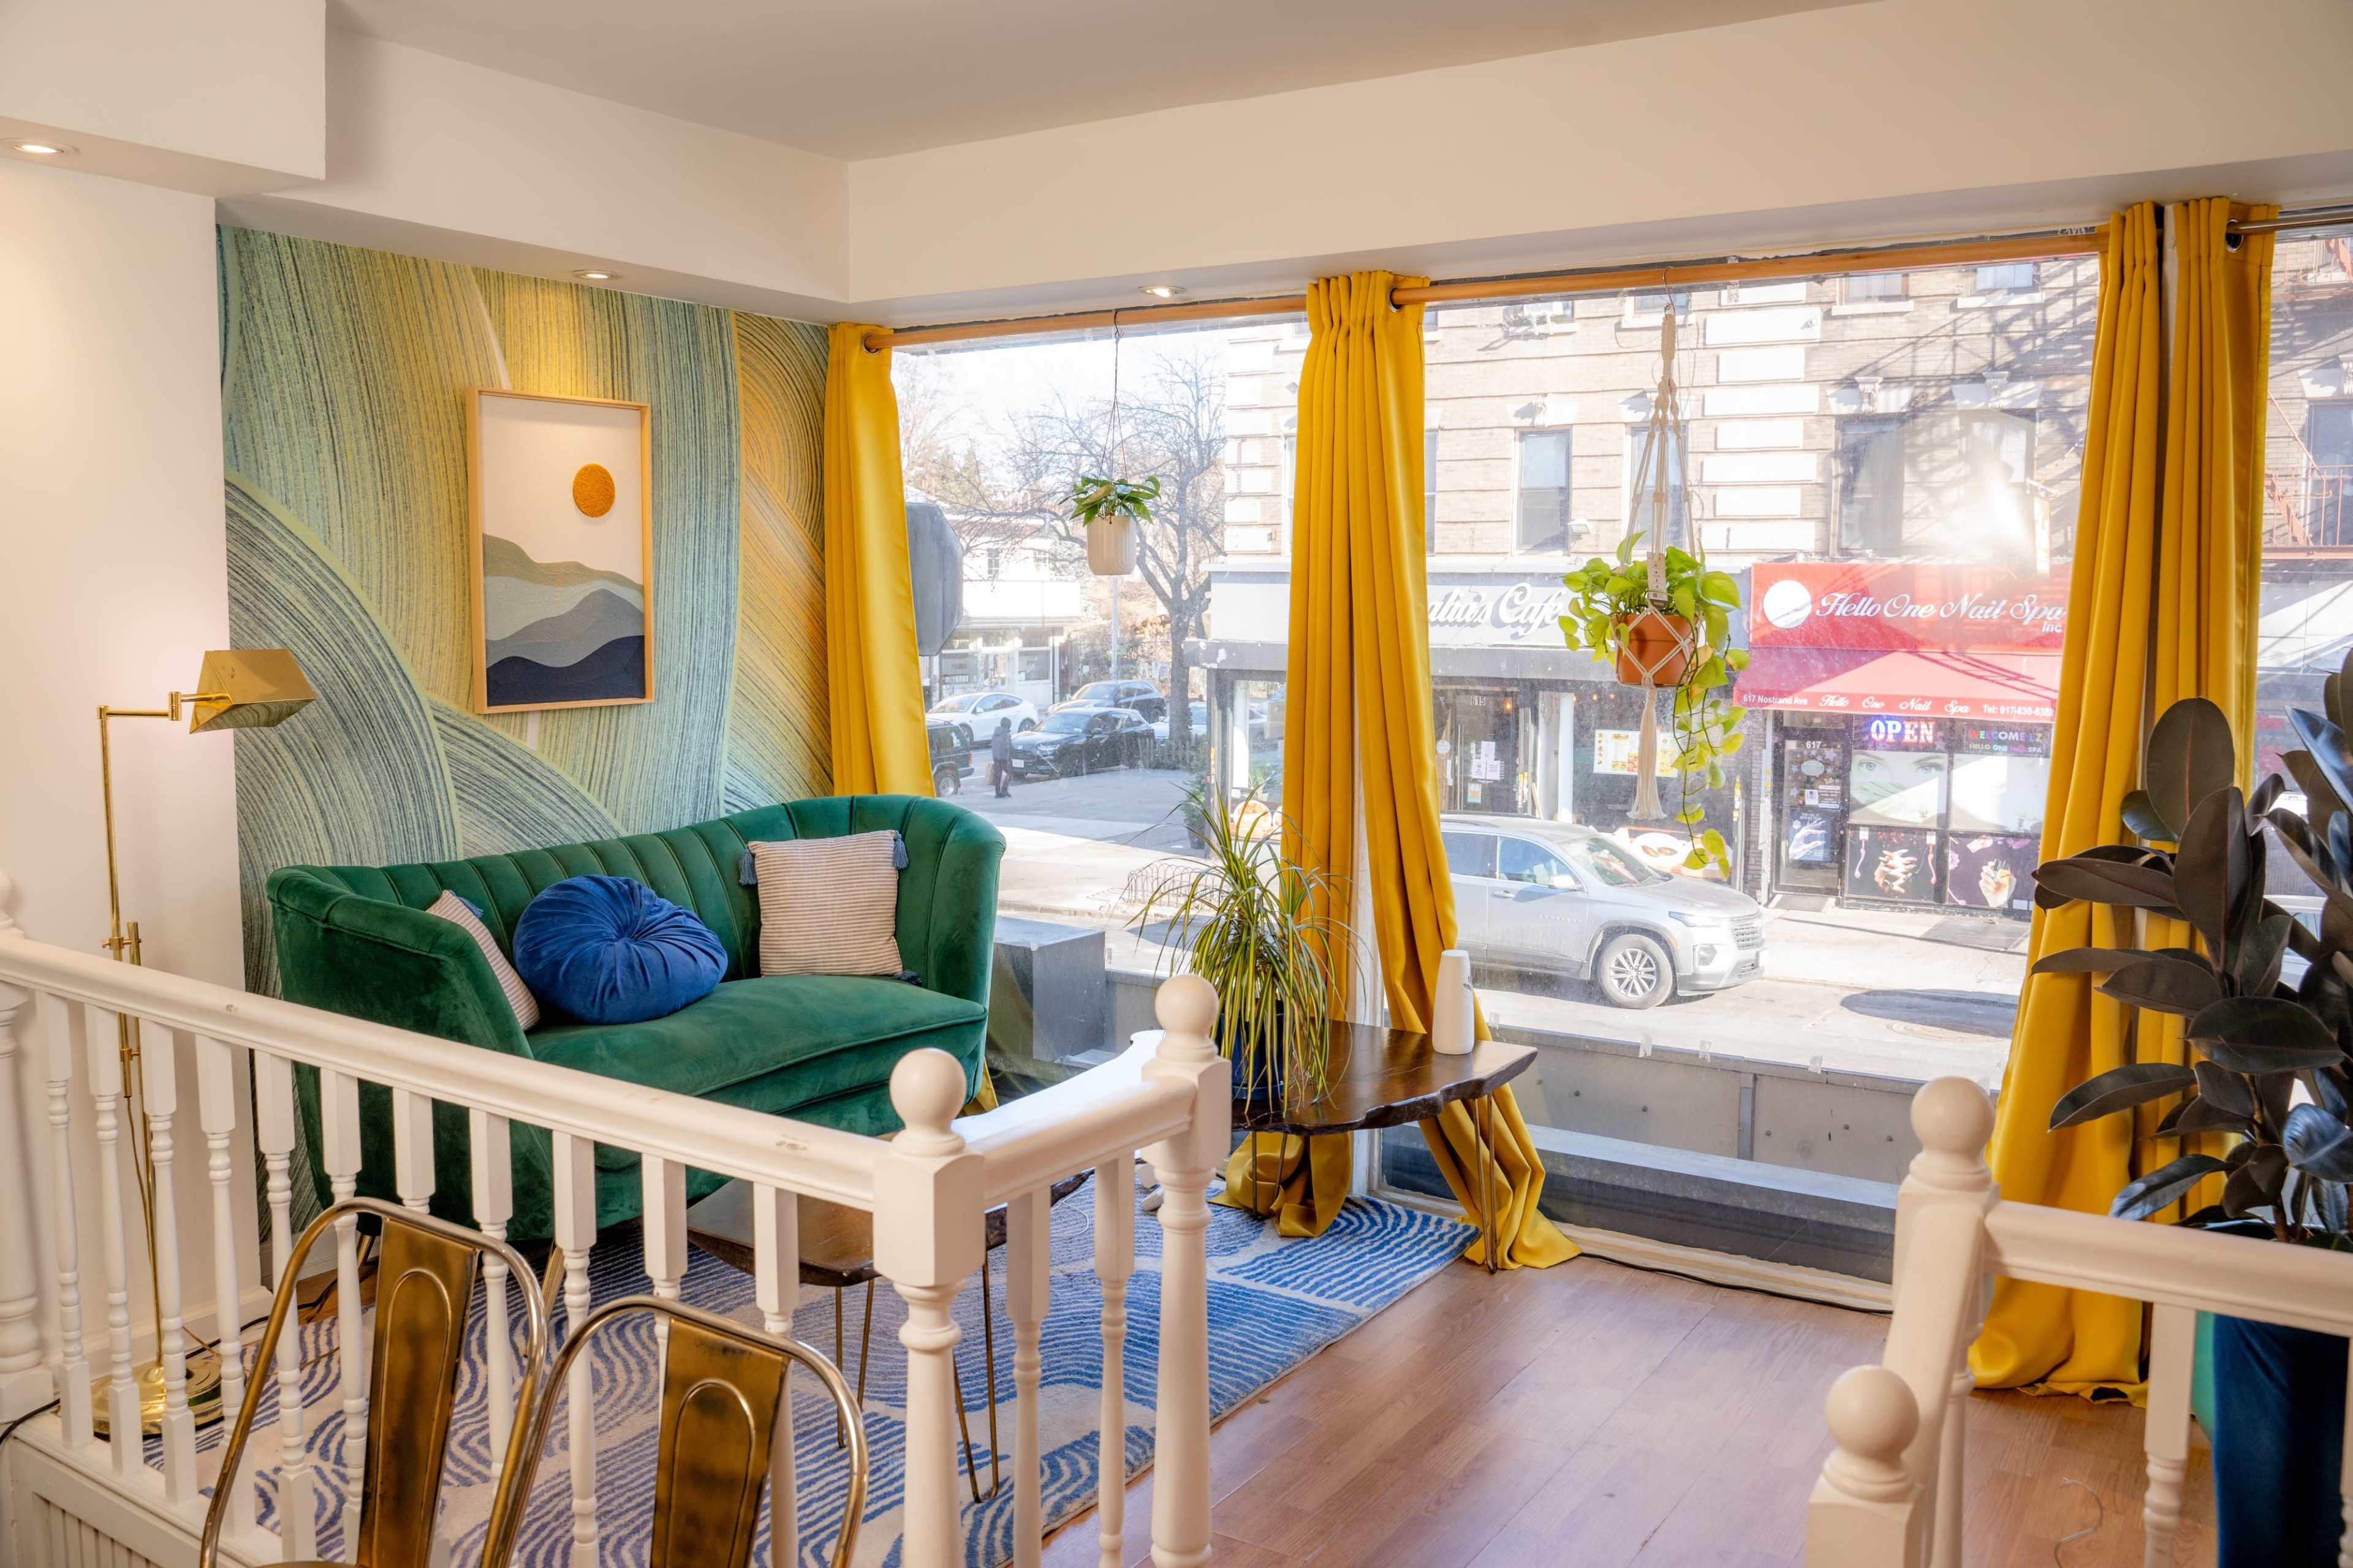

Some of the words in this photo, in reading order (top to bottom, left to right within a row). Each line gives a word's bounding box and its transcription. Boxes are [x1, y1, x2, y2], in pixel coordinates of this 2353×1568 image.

[1816, 592, 1881, 617] Hello
[1884, 593, 1936, 618] One
[1939, 593, 2007, 619] Nail
[2010, 594, 2067, 626] Spa
[2042, 621, 2062, 633] Inc
[1471, 696, 1485, 705] 615
[1757, 695, 1792, 705] Nostrand
[1794, 697, 1808, 705] Ave
[1819, 694, 1849, 706] Hello
[1862, 696, 1885, 708] One
[1899, 698, 1932, 711] Nail
[1944, 700, 1971, 714] Spa
[1983, 704, 1998, 714] Tel:
[1871, 719, 1935, 744] OPEN
[1968, 729, 2026, 741] WELCOME
